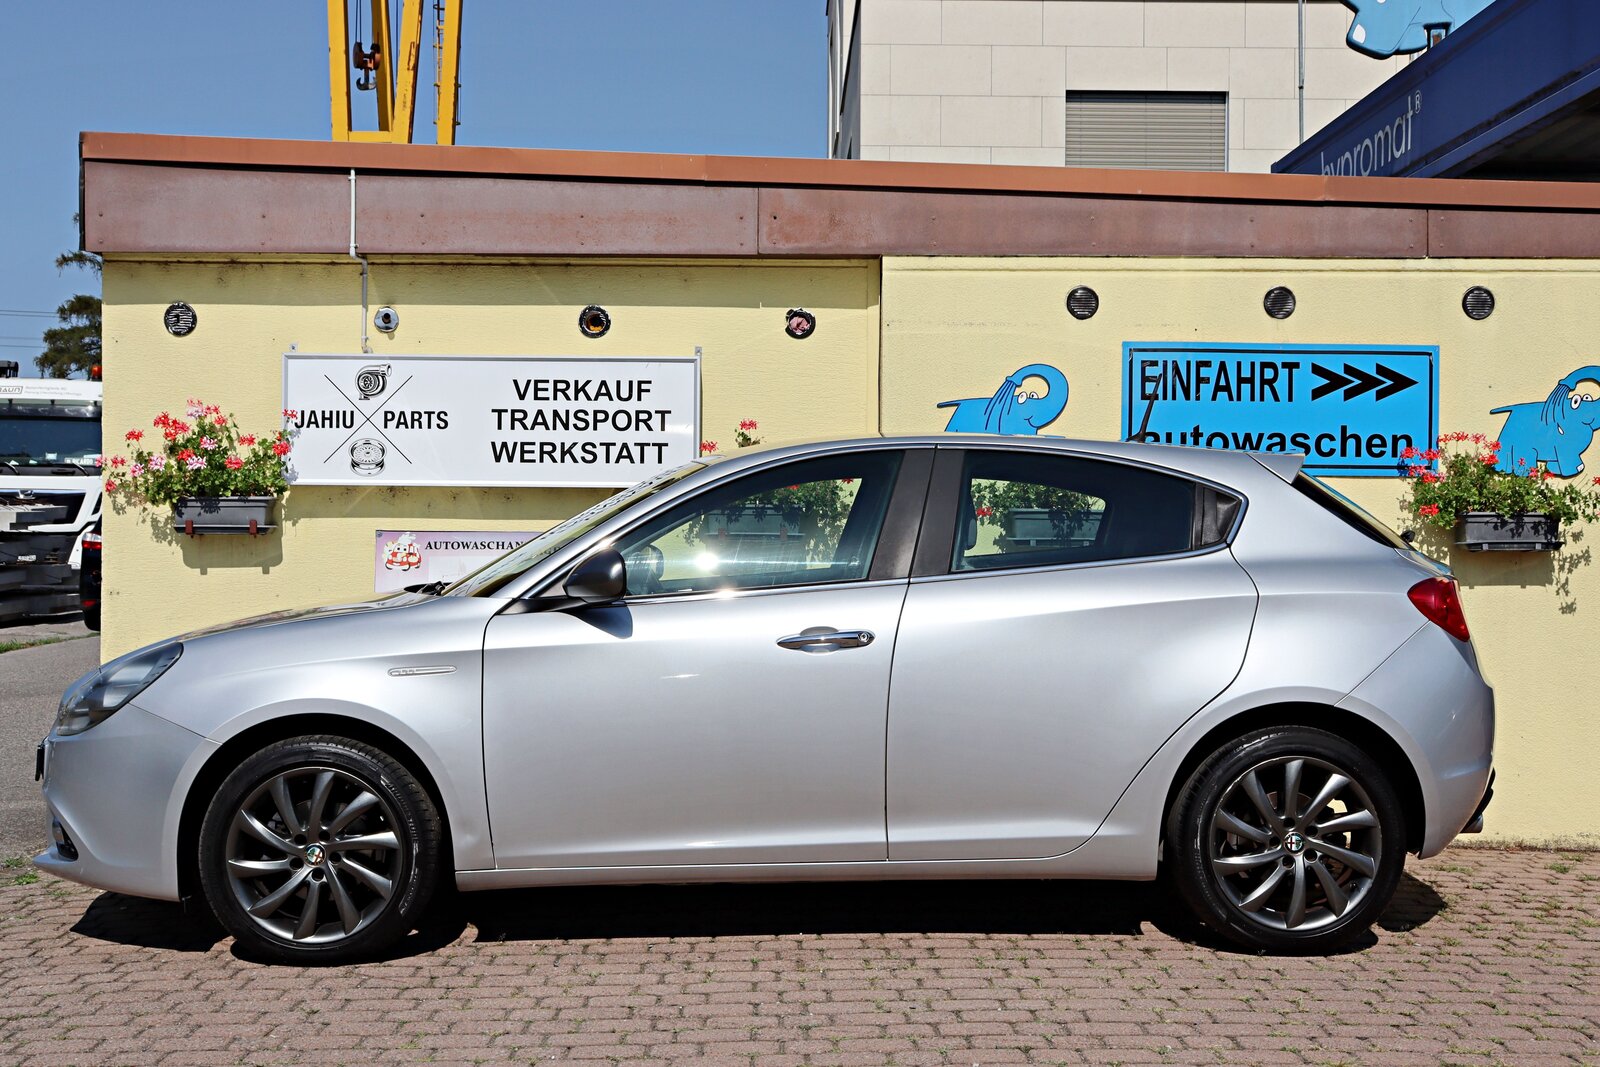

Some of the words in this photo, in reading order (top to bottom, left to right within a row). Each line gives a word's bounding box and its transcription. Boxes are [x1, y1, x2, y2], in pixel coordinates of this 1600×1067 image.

[513, 379, 653, 401] VERKAUF
[1140, 359, 1300, 402] EINFAHRT
[295, 410, 355, 429] JAHIU
[383, 410, 449, 430] PARTS
[491, 409, 672, 431] TRANSPORT
[490, 441, 669, 464] WERKSTATT
